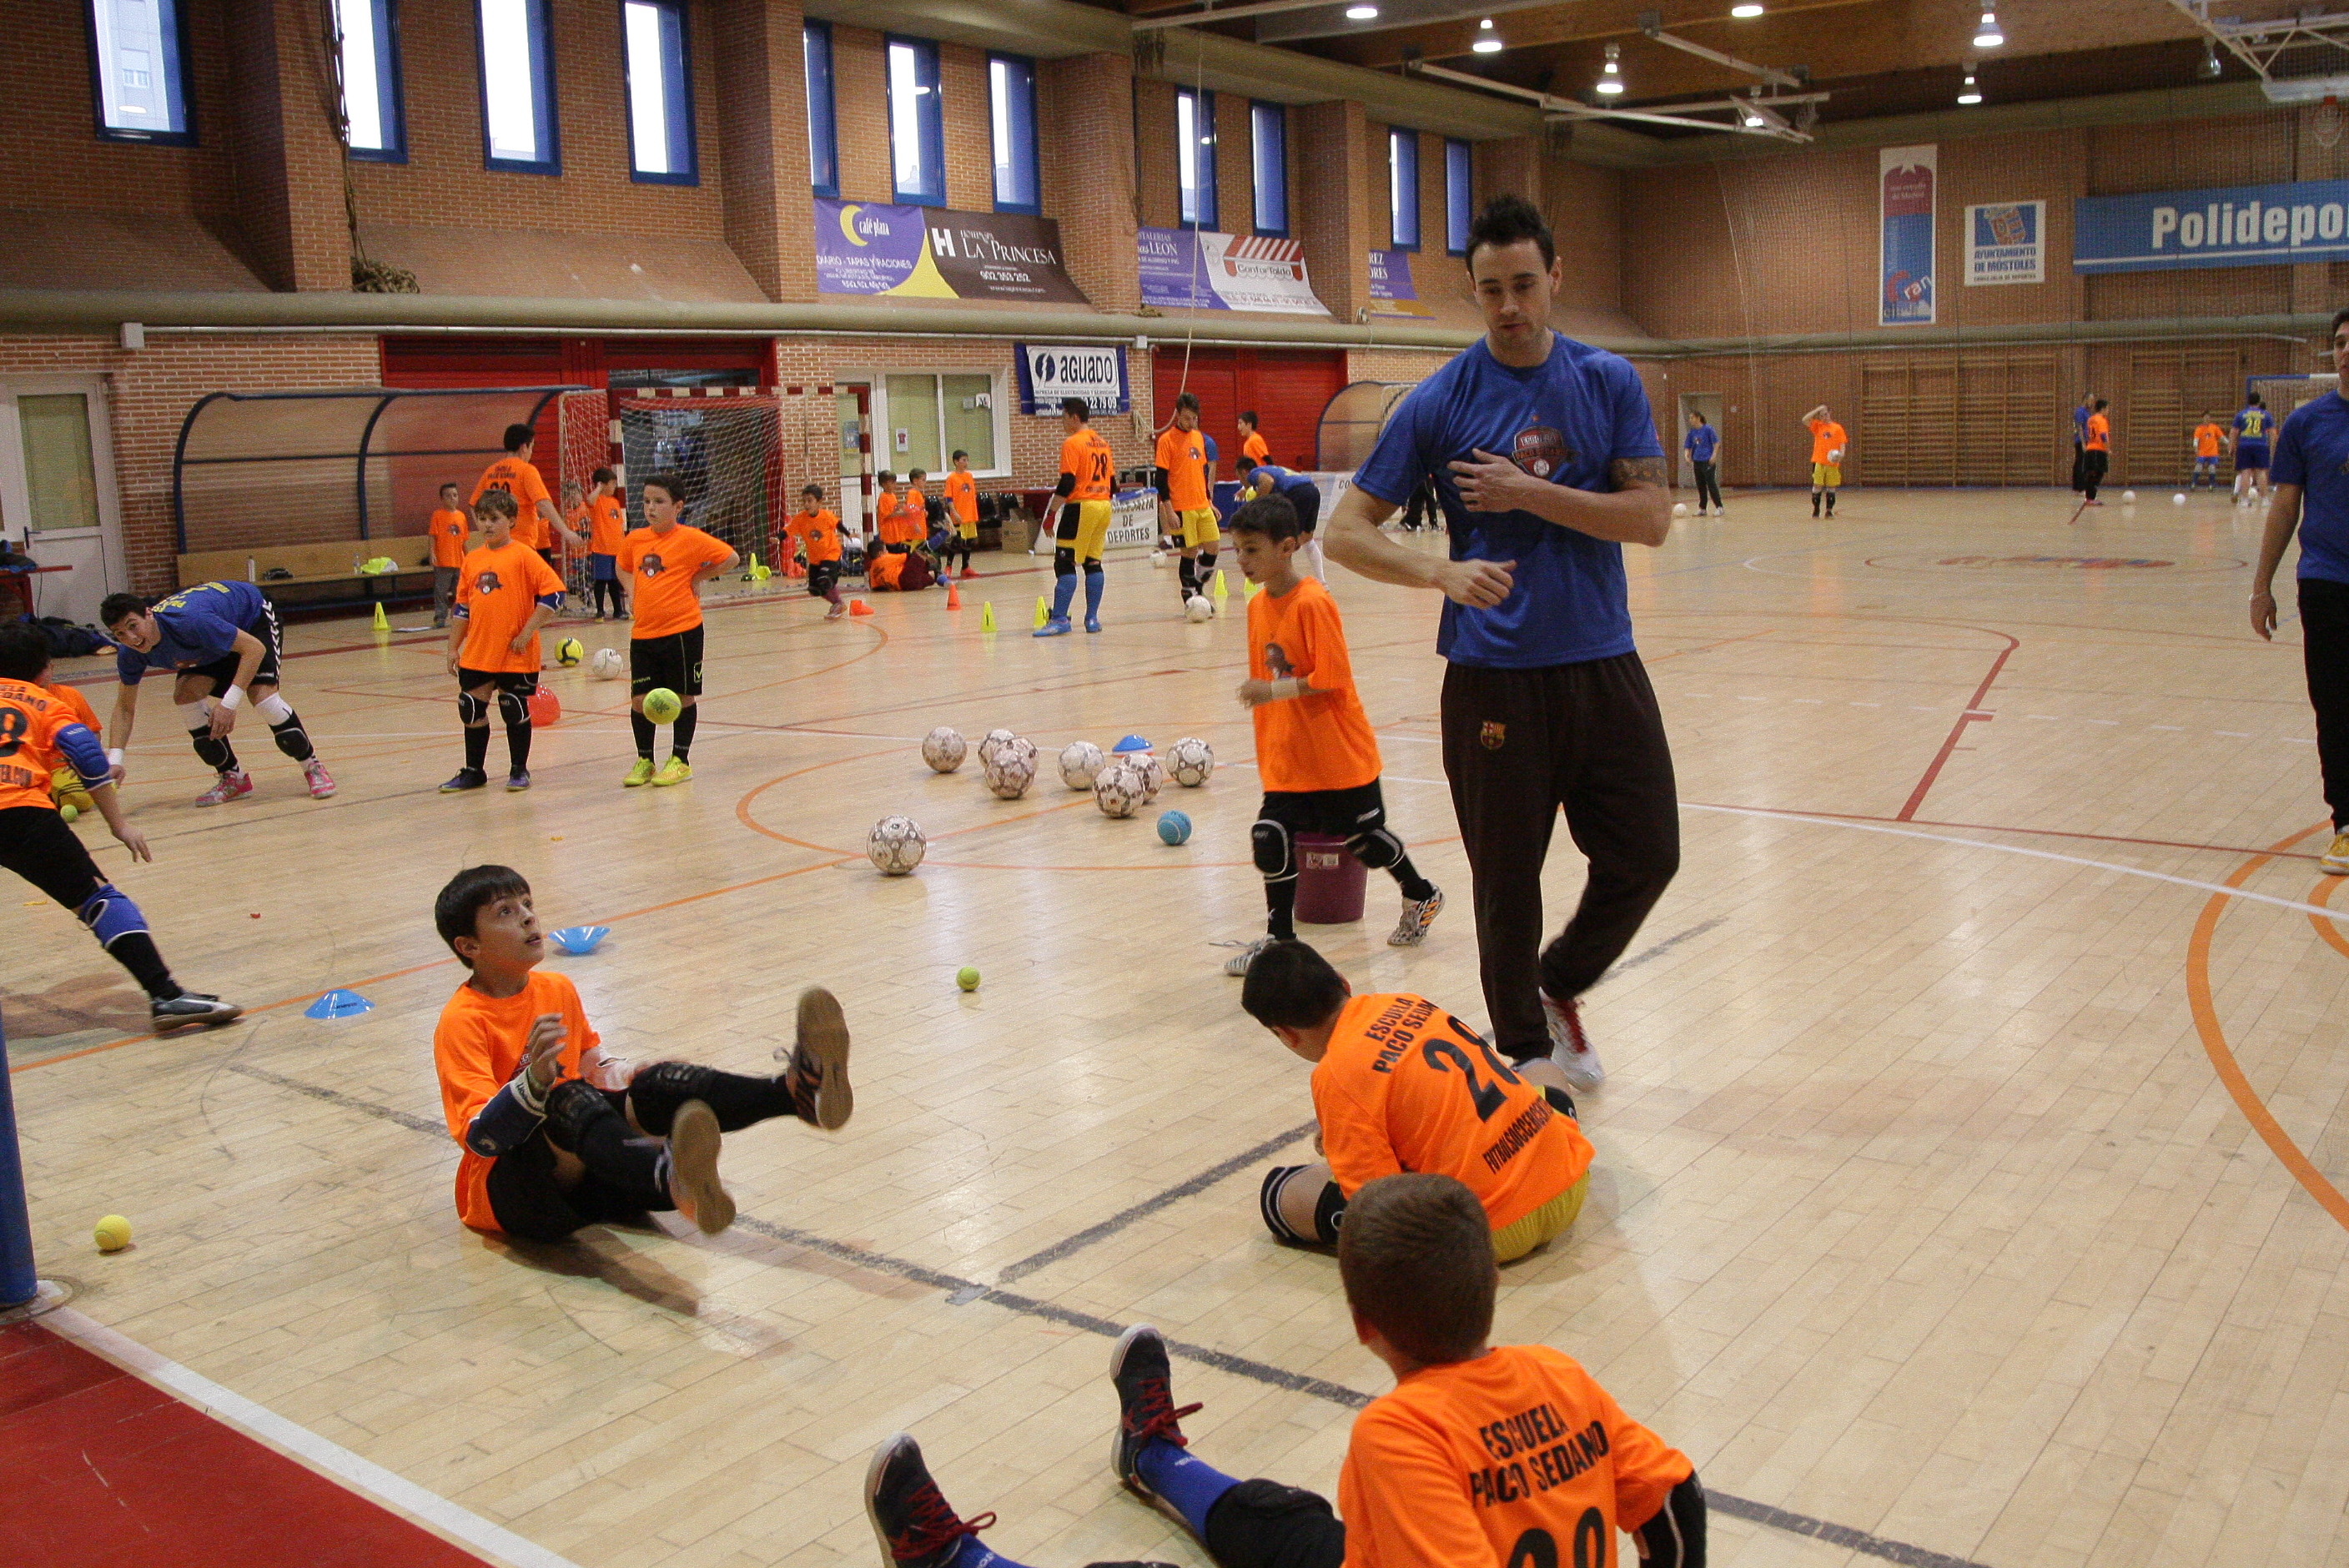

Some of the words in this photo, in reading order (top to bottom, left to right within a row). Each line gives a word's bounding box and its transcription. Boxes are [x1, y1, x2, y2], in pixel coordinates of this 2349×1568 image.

[931, 228, 956, 258] H
[2152, 200, 2349, 249] Polidepo
[991, 240, 1057, 265] PRINCESA
[1107, 527, 1149, 544] DEPORTES
[1123, 514, 1133, 527] DE
[1364, 997, 1414, 1043] ESCUELA
[1372, 1029, 1414, 1074] PACO
[1479, 1401, 1570, 1461] ESCUELA
[1469, 1462, 1531, 1508] PACO
[1528, 1420, 1610, 1491] SEDANO
